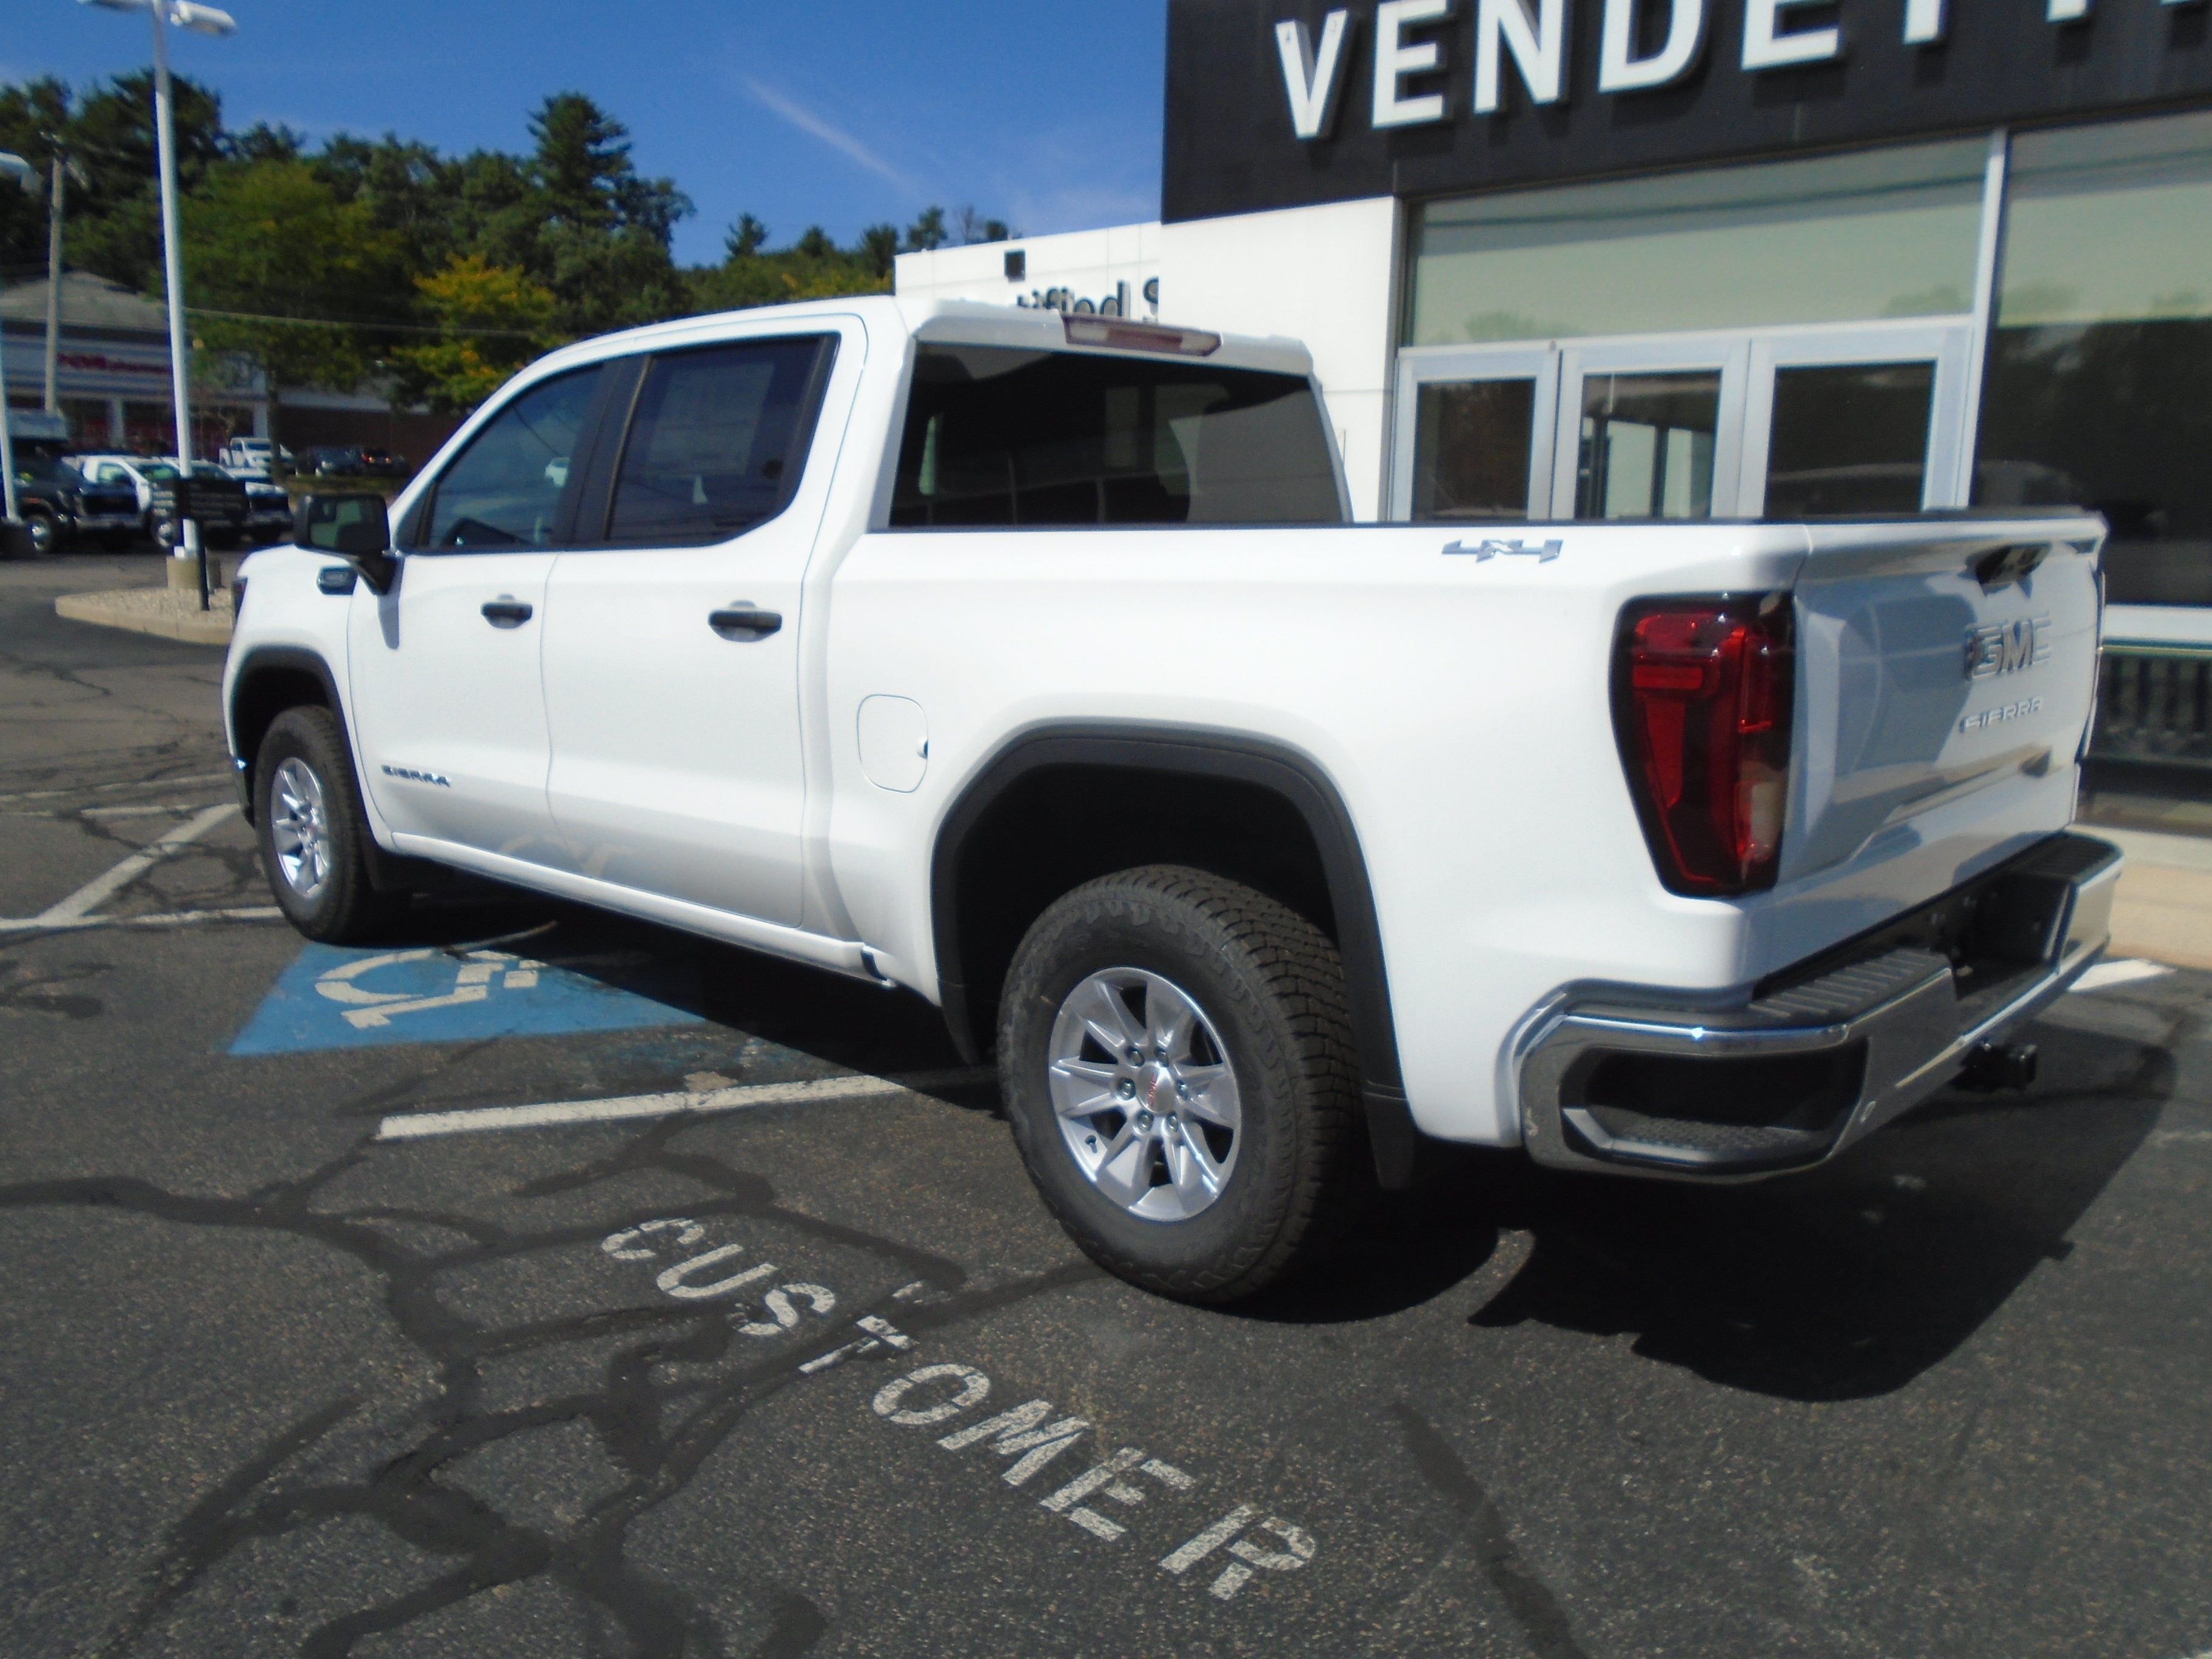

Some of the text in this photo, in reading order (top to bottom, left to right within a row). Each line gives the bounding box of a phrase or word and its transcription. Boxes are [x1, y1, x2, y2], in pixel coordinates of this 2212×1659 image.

[1965, 611, 2052, 680] GMC
[1959, 696, 2043, 732] SIERRA
[381, 765, 451, 788] SIERRA
[600, 1217, 1318, 1601] CUSTOMER
